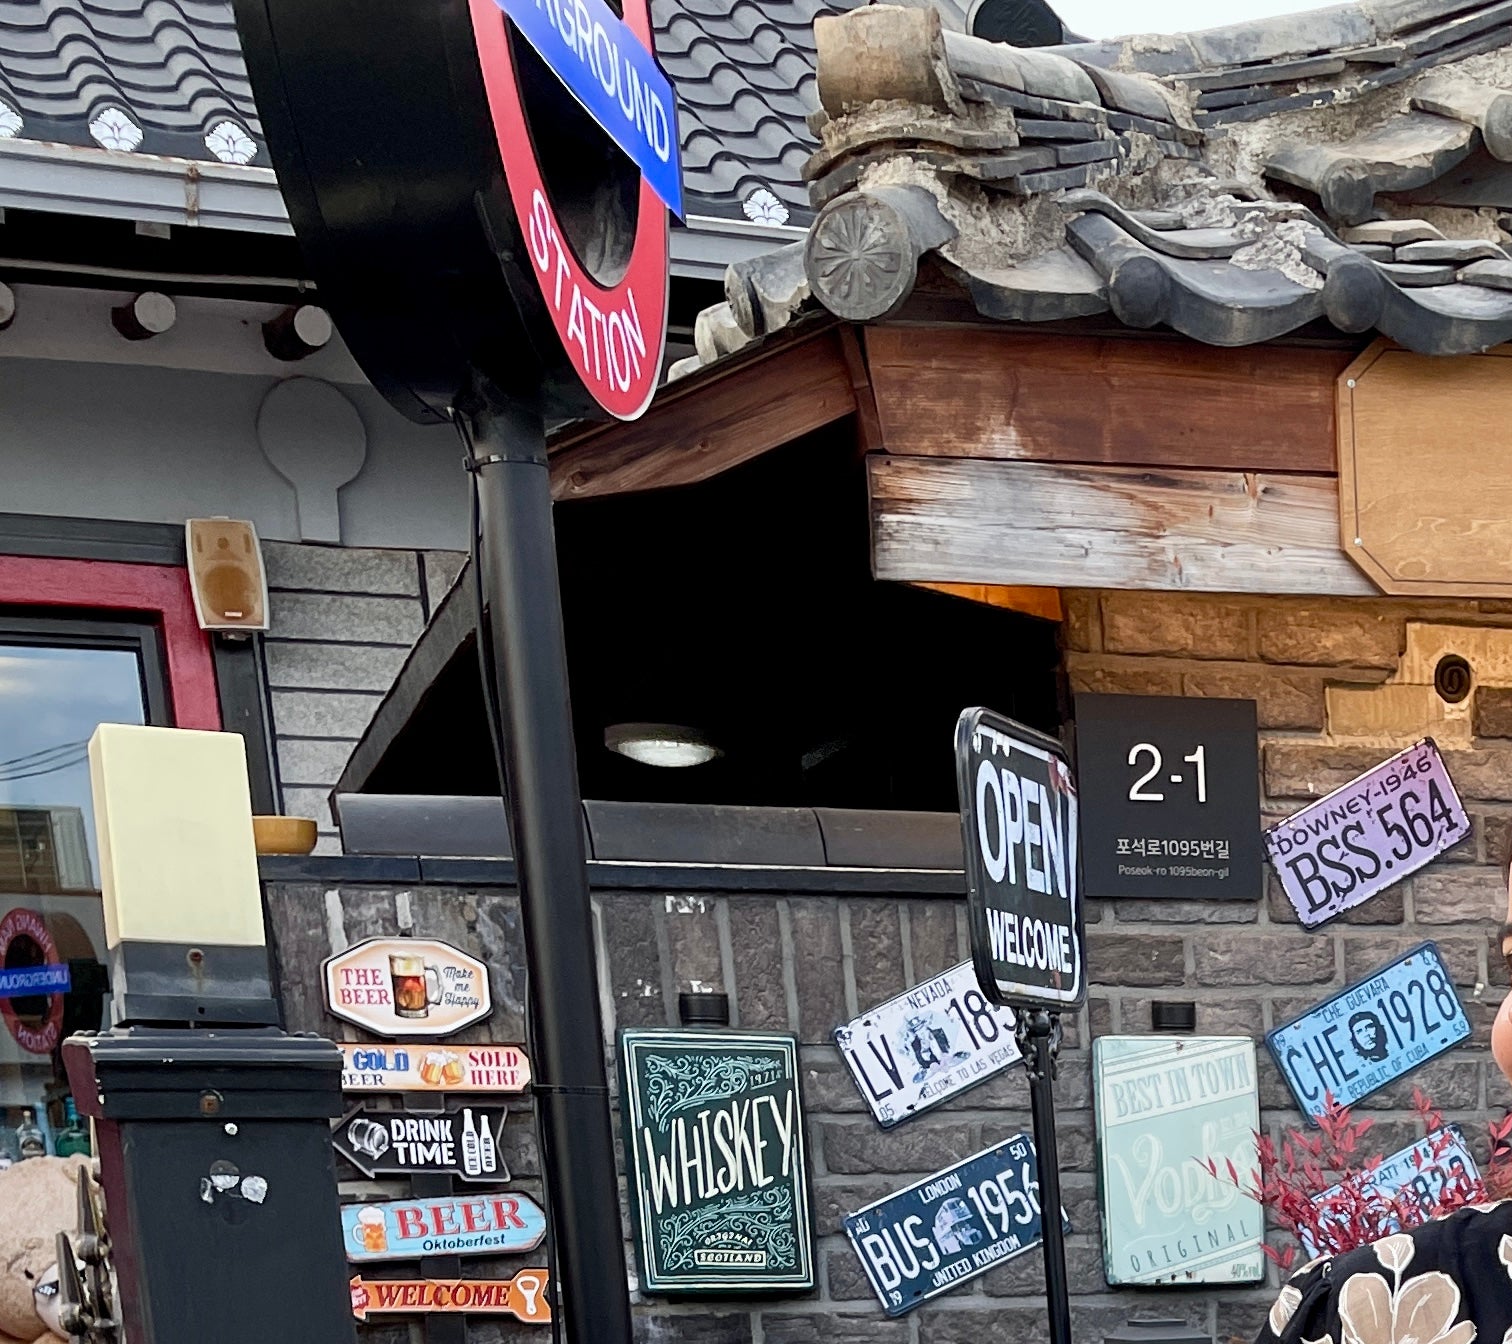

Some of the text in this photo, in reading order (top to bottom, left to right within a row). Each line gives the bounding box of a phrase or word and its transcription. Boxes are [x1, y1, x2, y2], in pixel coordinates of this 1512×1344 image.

[529, 188, 647, 393] STATION
[1127, 742, 1207, 803] 2-1
[1276, 755, 1433, 857] DOWNEY-1946
[975, 759, 1068, 899] OPEN
[1115, 838, 1230, 860] 포석로1095번길
[1285, 777, 1459, 916] BSS.564
[985, 907, 1073, 974] WELCOME
[340, 968, 385, 987] THE
[443, 966, 475, 980] Make
[340, 988, 392, 1006] BEER
[906, 977, 954, 1010] NEVADA
[1348, 976, 1391, 1012] GUEVARA
[1286, 969, 1458, 1102] CHE 1928
[352, 1048, 410, 1072] COLD
[468, 1051, 519, 1068] SOLD
[850, 1033, 905, 1103] LV
[1405, 1043, 1431, 1063] CUBA
[470, 1069, 521, 1086] HERE
[1109, 1052, 1252, 1118] BEST IN TOWN
[391, 1119, 453, 1142] DRINK
[391, 1142, 457, 1165] TIME
[644, 1089, 794, 1215] WHISKEY
[1009, 1141, 1027, 1161] 50
[918, 1172, 963, 1205] LONDON
[393, 1198, 529, 1240] BEER
[422, 1233, 506, 1252] Oktoberfest
[861, 1214, 941, 1292] BUS
[971, 1233, 1022, 1268] KINGDOM
[1129, 1219, 1250, 1273] ORIGINAL
[374, 1284, 512, 1310] WELCOME
